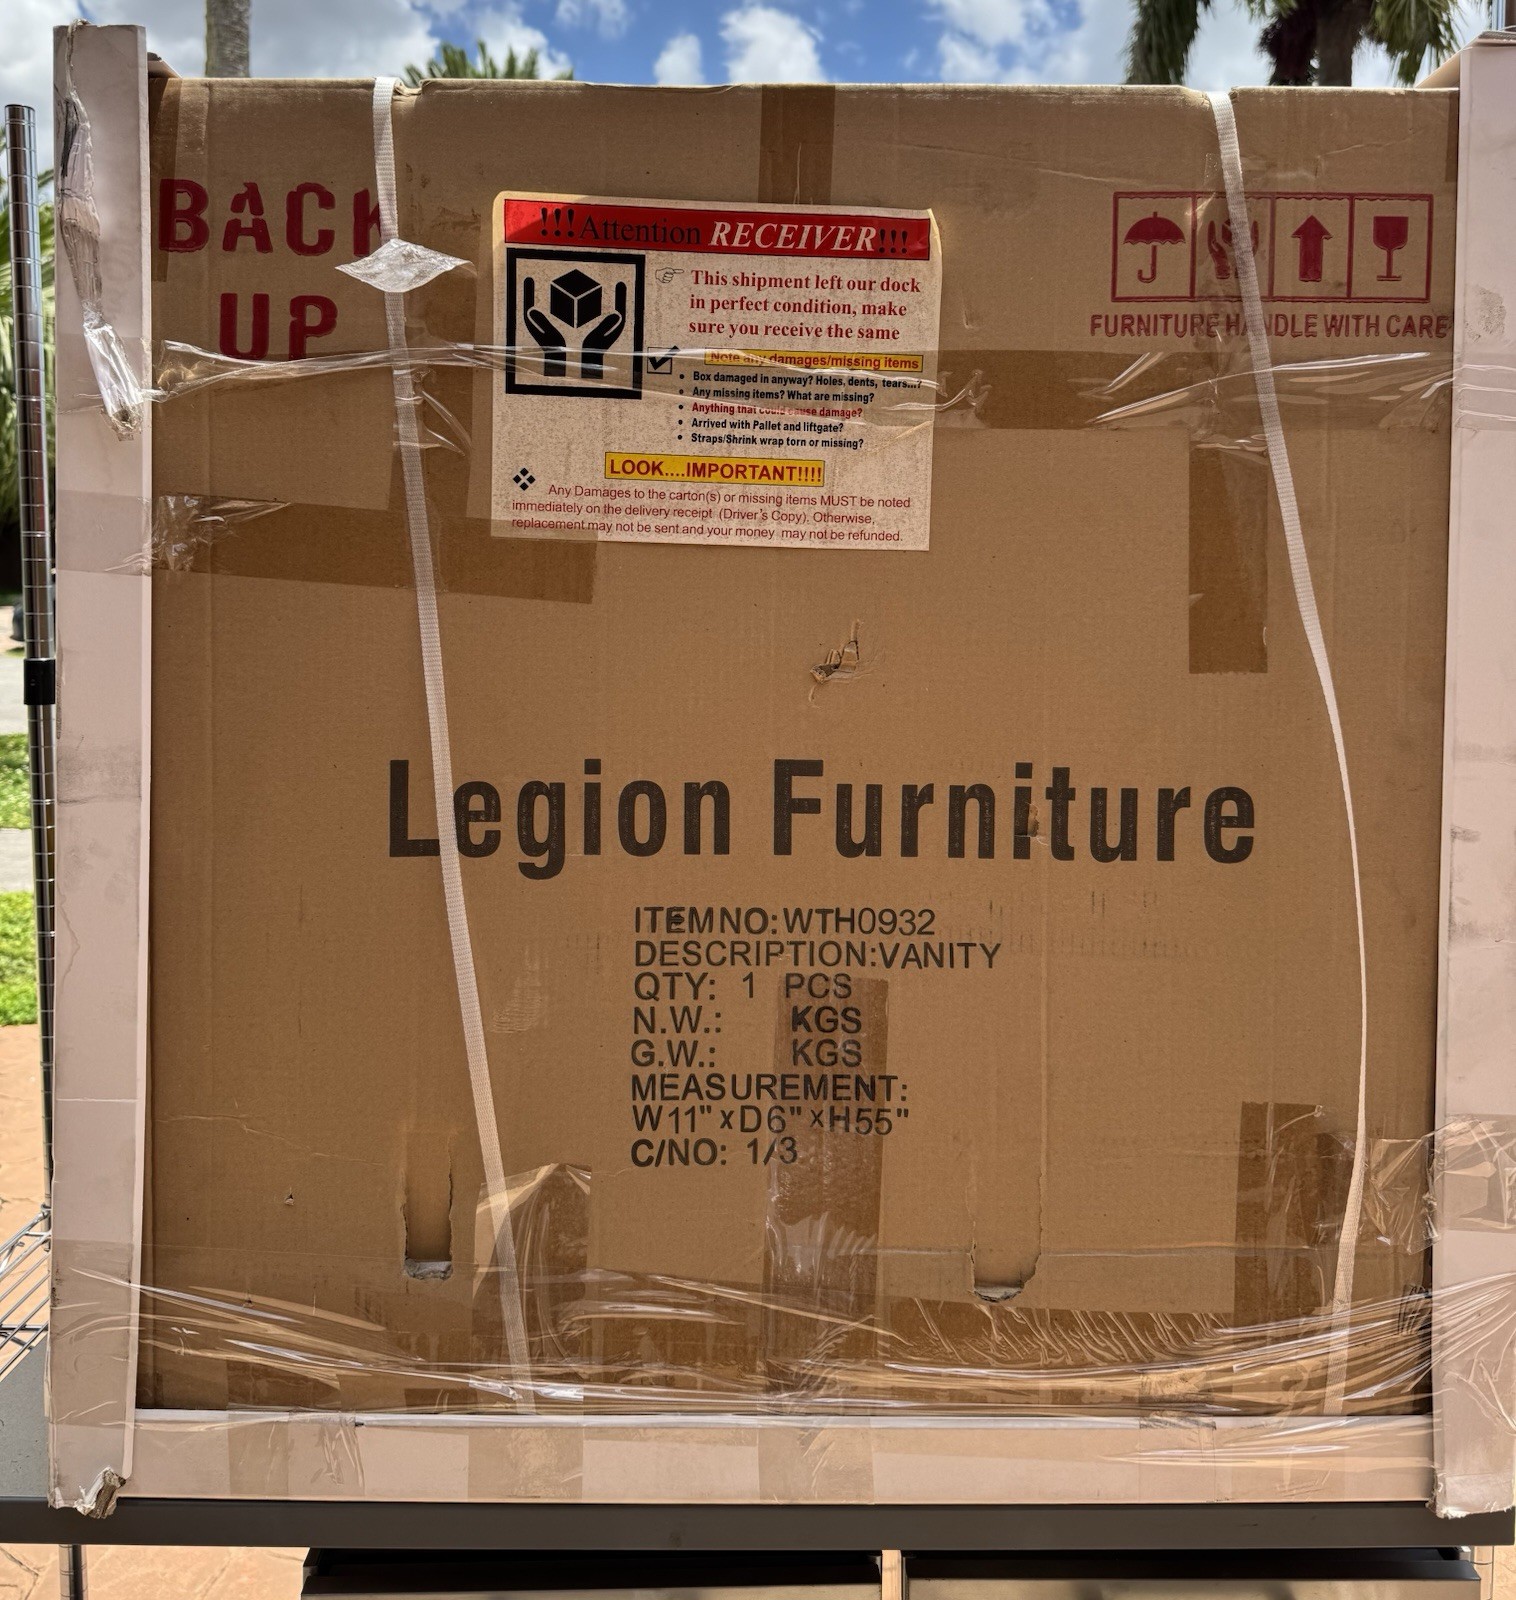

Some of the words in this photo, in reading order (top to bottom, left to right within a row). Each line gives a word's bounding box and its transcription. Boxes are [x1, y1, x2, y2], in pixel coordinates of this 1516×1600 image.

[159, 178, 381, 257] BACK
[708, 221, 908, 254] RECEIVER!!!
[691, 269, 728, 286] This
[732, 272, 810, 290] shipment
[815, 275, 843, 289] left
[847, 279, 876, 290] our
[880, 277, 921, 293] dock
[690, 294, 705, 309] in
[710, 296, 769, 313] perfect
[773, 299, 857, 316] condition,
[861, 302, 907, 316] make
[219, 293, 338, 360] UP
[689, 321, 725, 333] sure
[729, 324, 759, 338] you
[764, 323, 822, 338] receive
[827, 324, 853, 339] the
[857, 327, 900, 340] same
[1090, 313, 1220, 338] FURNITURE
[1324, 314, 1380, 338] WITH
[1386, 314, 1450, 338] CARE
[711, 352, 740, 363] Note
[769, 354, 880, 371] damages/missing
[884, 356, 919, 369] items
[693, 371, 711, 381] Box
[714, 372, 758, 385] damaged
[761, 374, 769, 384] in
[772, 375, 813, 387] anyway?
[816, 375, 846, 387] Holes,
[848, 376, 877, 389] dents,
[693, 387, 711, 399] Any
[713, 388, 750, 401] missing
[752, 389, 785, 399] items?
[787, 390, 812, 400] What
[814, 393, 830, 402] are
[832, 392, 875, 404] missing?
[692, 402, 735, 415] Anything
[737, 405, 756, 414] that
[819, 408, 863, 419] damage?
[692, 418, 727, 429] Arrived
[730, 419, 750, 429] with
[753, 420, 781, 431] Pallet
[783, 421, 801, 432] and
[803, 421, 844, 434] liftgate?
[691, 433, 757, 446] Straps/Shrink
[759, 437, 784, 448] wrap
[786, 437, 807, 447] torn
[809, 438, 819, 447] or
[821, 437, 864, 450] missing?
[549, 485, 571, 498] Any
[575, 485, 631, 499] Damages
[634, 488, 644, 498] to
[648, 488, 666, 499] the
[669, 490, 721, 503] carton(s)
[724, 494, 736, 503] or
[738, 494, 782, 507] missing
[786, 494, 817, 505] items
[820, 495, 857, 507] MUST
[860, 497, 875, 507] be
[877, 497, 911, 508] noted
[512, 500, 582, 514] immediately
[585, 504, 600, 513] on
[603, 504, 622, 514] the
[625, 504, 670, 519] delivery
[673, 507, 713, 519] receipt
[771, 511, 810, 524] Copy).
[813, 512, 875, 525] Otherwise,
[512, 518, 585, 532] replacement
[588, 521, 612, 533] may
[615, 521, 633, 532] not
[637, 522, 651, 533] be
[654, 524, 679, 534] sent
[682, 524, 704, 535] and
[707, 527, 733, 538] your
[735, 528, 775, 539] money
[781, 530, 806, 541] may
[810, 529, 828, 539] not
[830, 529, 844, 540] be
[848, 530, 903, 542] refunded.
[389, 758, 730, 880] Legion
[774, 758, 1255, 863] Furniture
[633, 971, 715, 1001] QTY:
[742, 974, 755, 999] 1
[785, 973, 852, 999] PCS
[633, 1005, 722, 1034] N.W.:
[791, 1005, 862, 1034] KGS
[631, 1040, 715, 1068] G.W.:
[791, 1039, 862, 1067] KGS
[631, 1073, 907, 1101] MEASUREMENT:
[631, 1138, 727, 1167] C/NO:
[747, 1138, 798, 1166] 1/3
